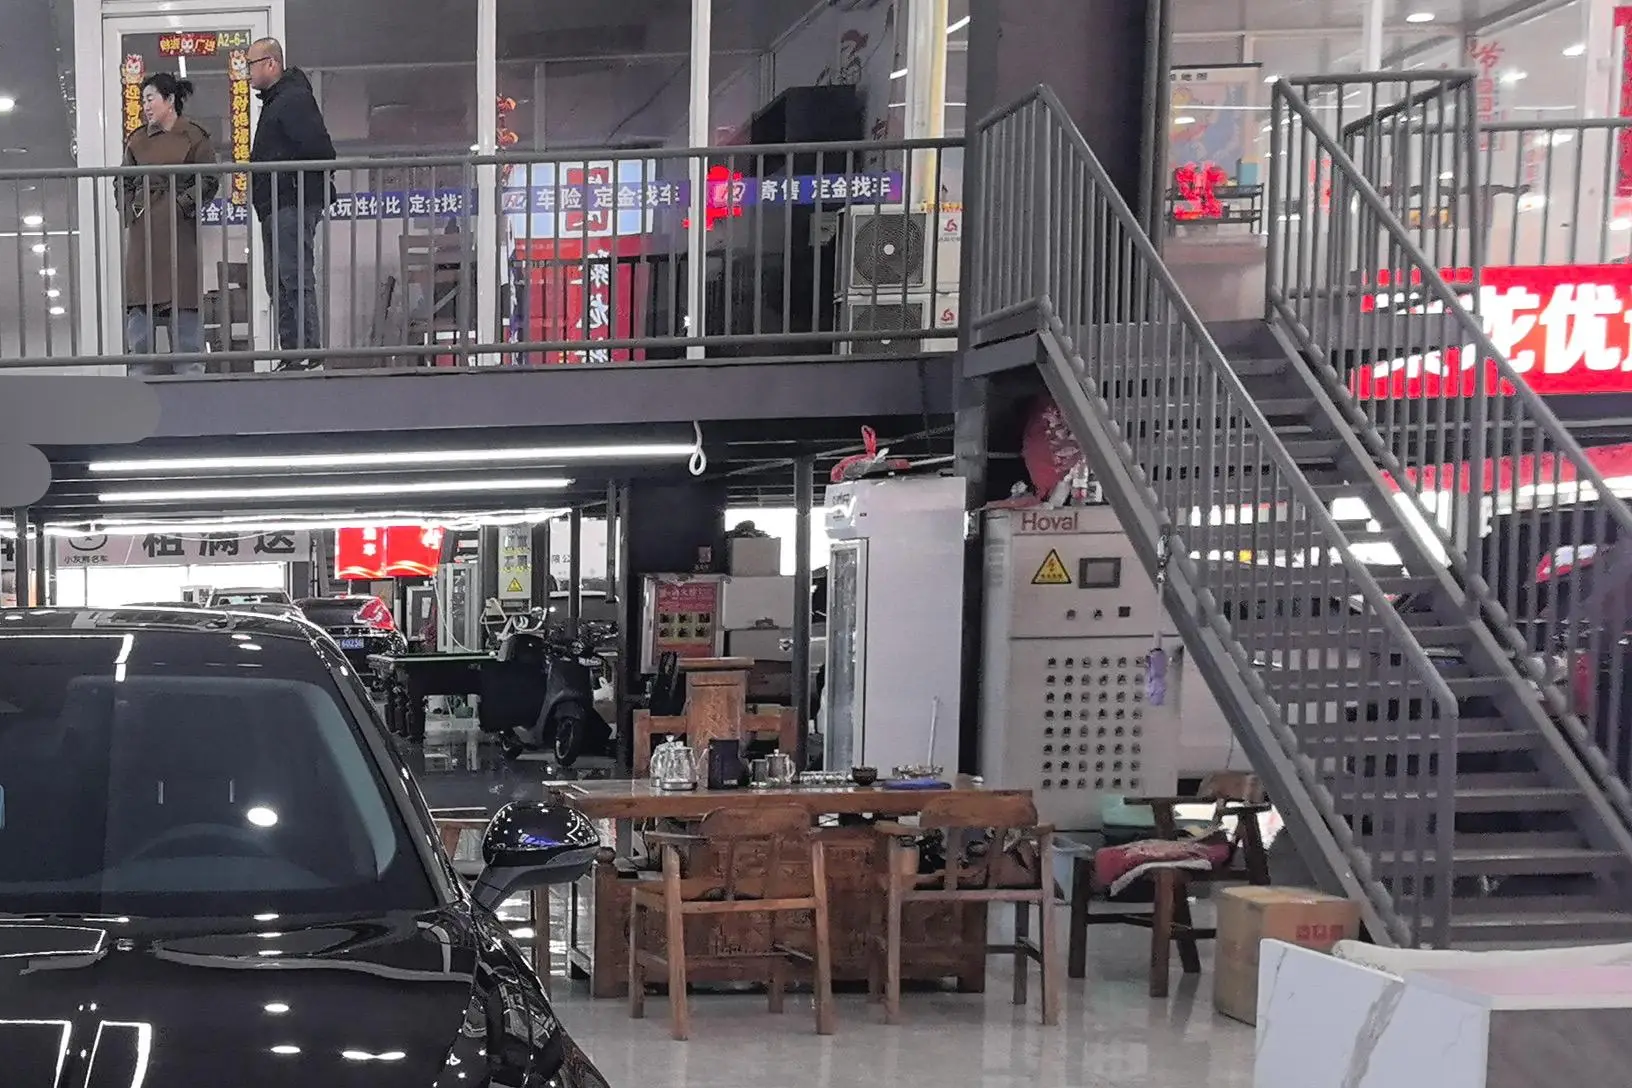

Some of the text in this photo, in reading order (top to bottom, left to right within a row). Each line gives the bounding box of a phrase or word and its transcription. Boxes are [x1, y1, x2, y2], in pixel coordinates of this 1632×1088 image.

[217, 32, 249, 47] A2-6-1
[409, 194, 473, 214] 定金找
[536, 188, 582, 211] 车险
[201, 202, 248, 222] 金找车
[1021, 512, 1079, 531] Hoval
